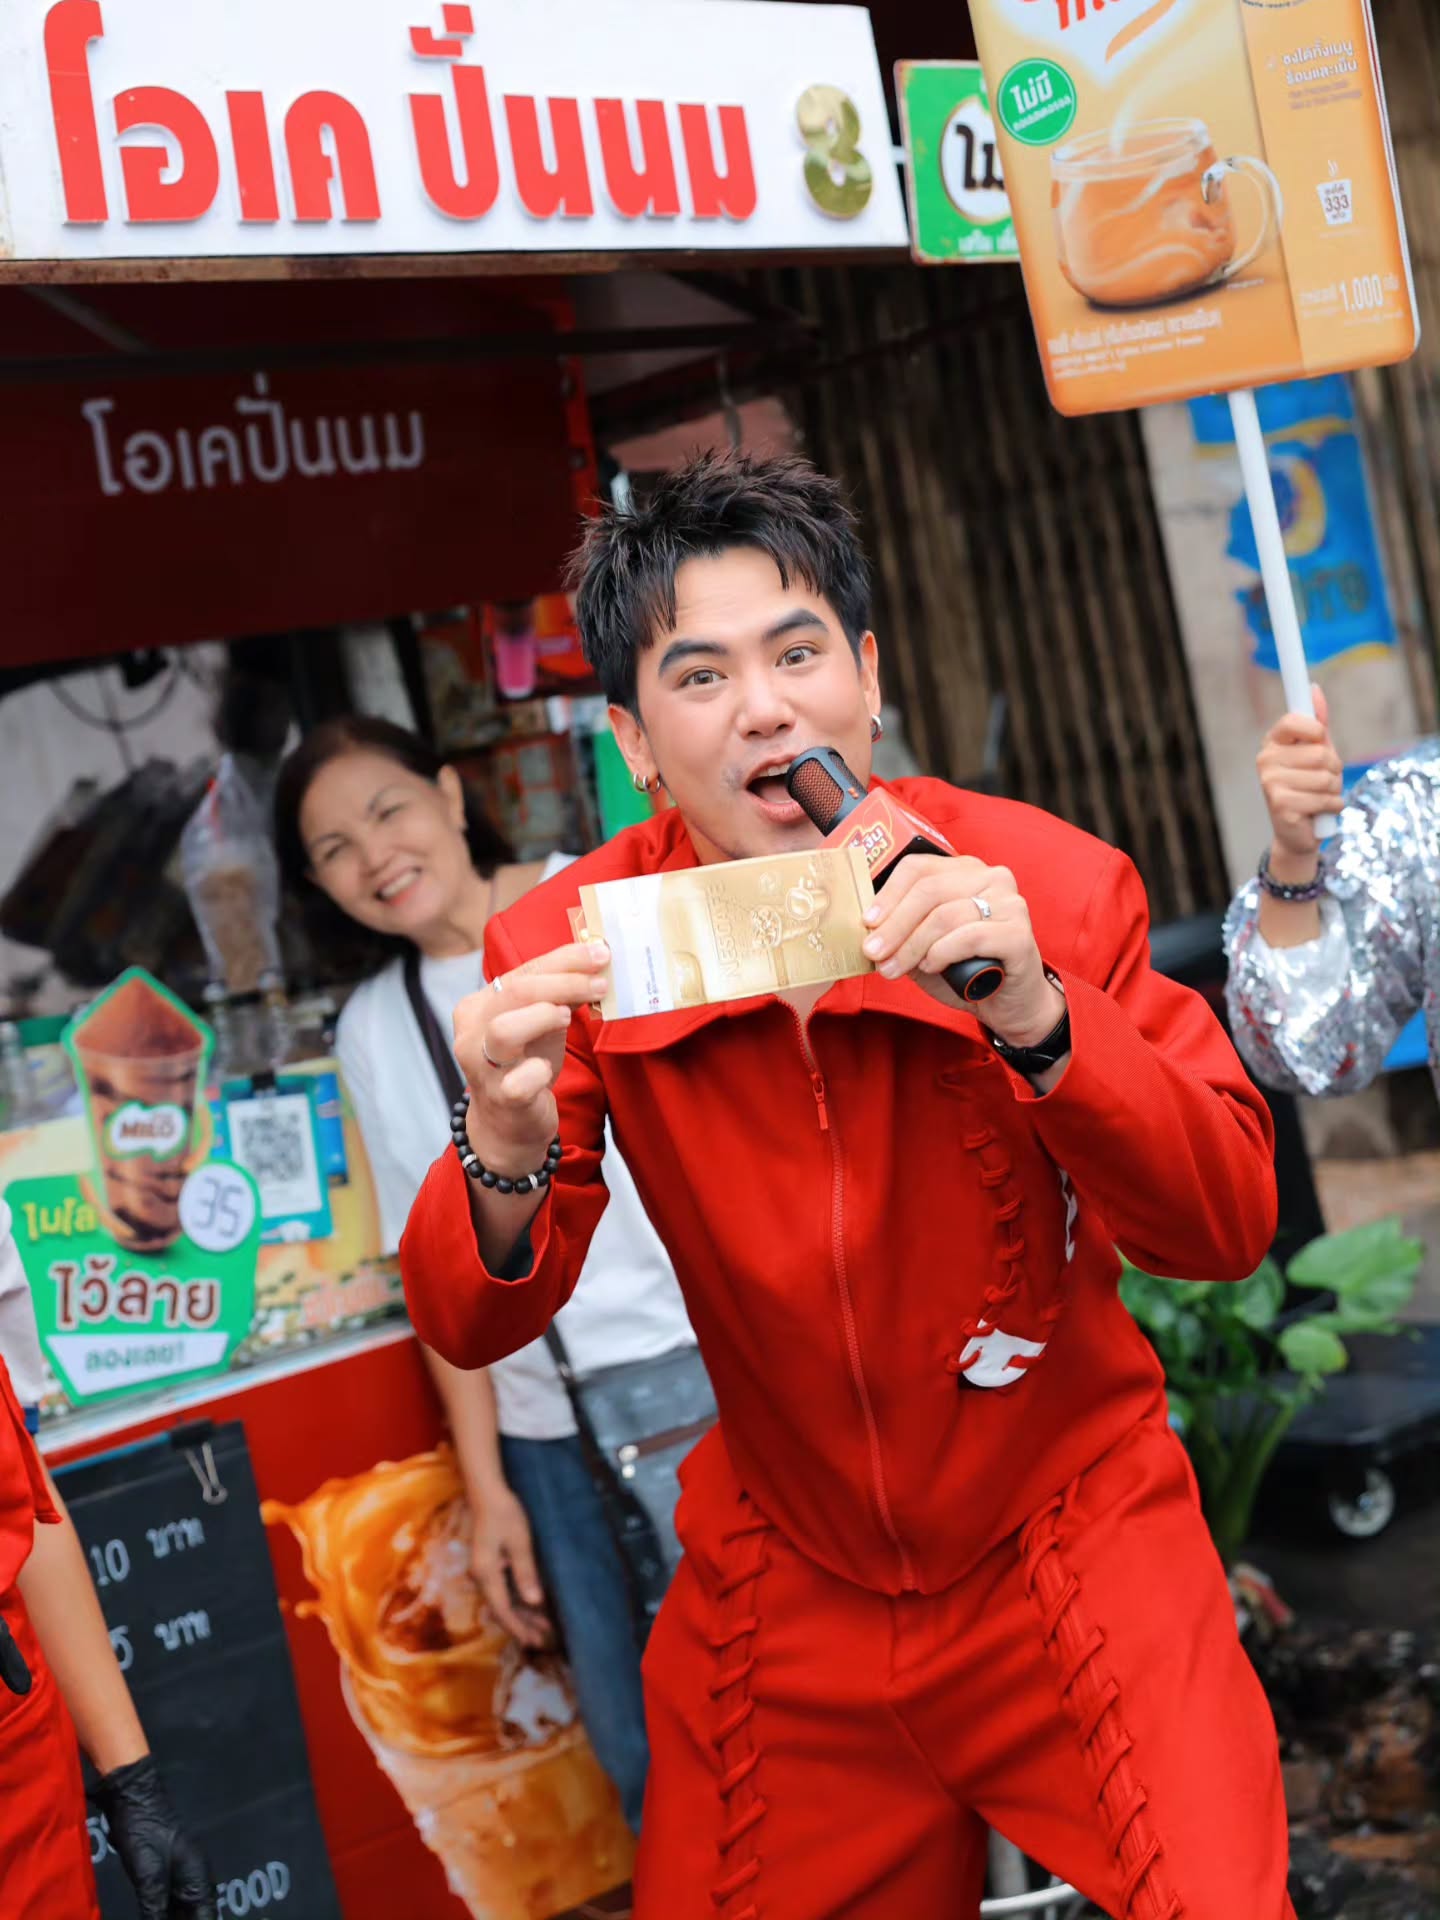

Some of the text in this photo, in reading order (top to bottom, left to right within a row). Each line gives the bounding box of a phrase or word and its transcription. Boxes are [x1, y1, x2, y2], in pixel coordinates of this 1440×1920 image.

[44, 0, 874, 222] โอเค ปั่นนม 8
[1009, 70, 1053, 115] ไม่มี
[1324, 194, 1350, 213] 333
[84, 373, 423, 495] โอเคปั่นนม
[118, 1114, 175, 1139] MILO
[22, 1197, 97, 1241] ไมโล
[191, 1175, 244, 1239] 35
[53, 1257, 215, 1325] ไว้ลาย
